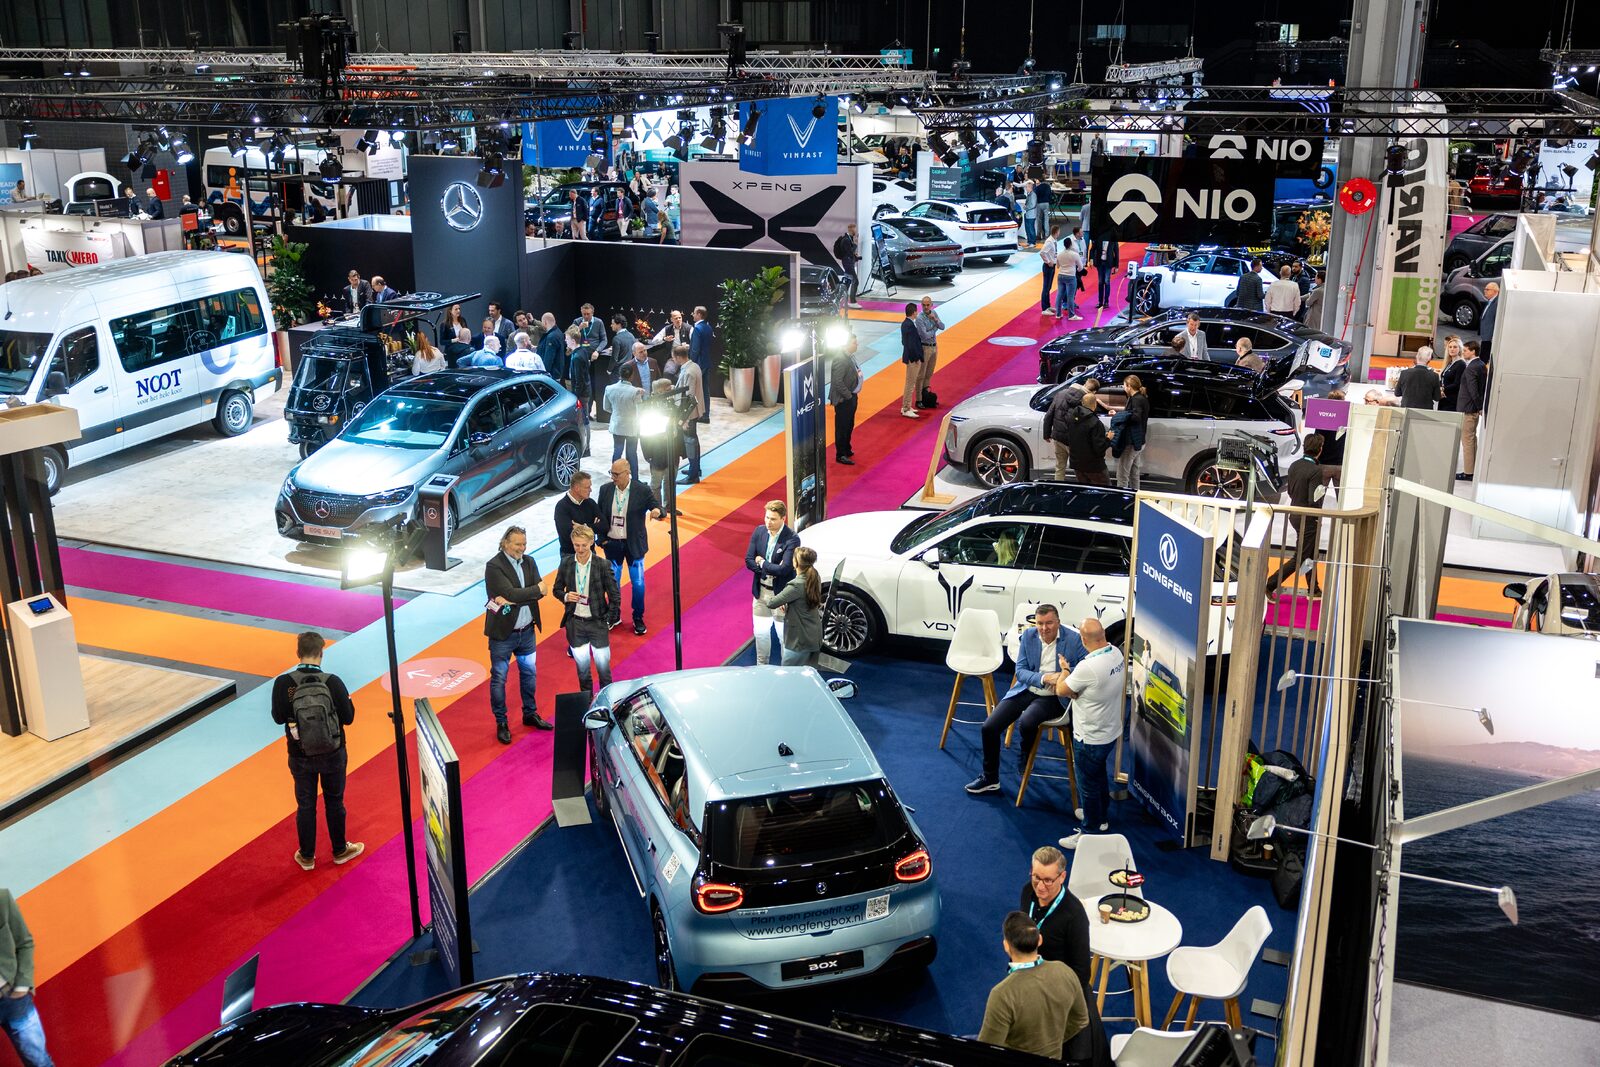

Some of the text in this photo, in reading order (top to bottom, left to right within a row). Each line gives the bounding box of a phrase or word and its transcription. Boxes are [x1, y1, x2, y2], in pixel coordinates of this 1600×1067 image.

[1255, 138, 1313, 162] NIO
[732, 182, 802, 192] XPENG
[1175, 188, 1257, 222] NIO
[136, 368, 182, 398] NOOT
[1142, 562, 1192, 604] DONGFENG
[923, 620, 956, 632] VOY
[1133, 779, 1179, 830] DONGFENG BOX
[746, 912, 864, 938] www.dongfengbox.nl
[751, 915, 776, 925] Plan
[779, 912, 802, 921] een
[804, 905, 842, 920] proefrit
[845, 904, 860, 913] op
[808, 960, 838, 971] BOX
